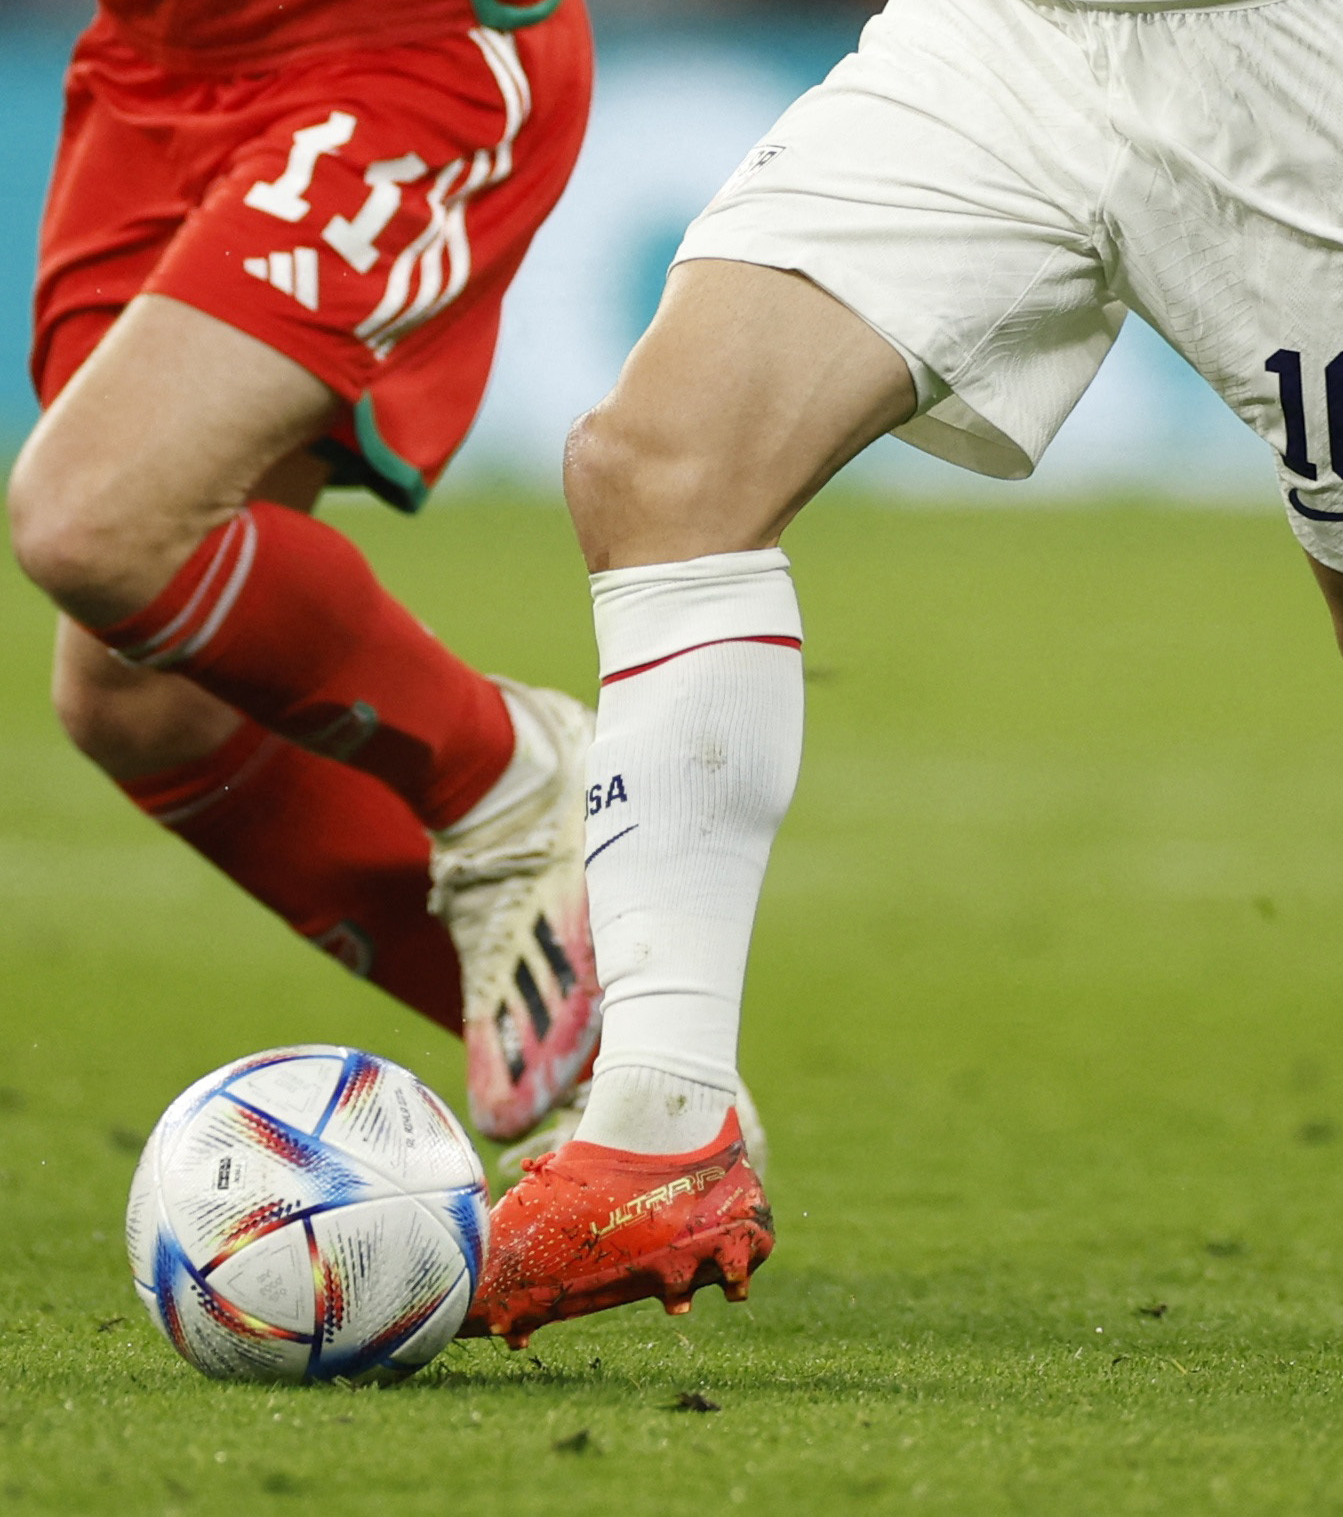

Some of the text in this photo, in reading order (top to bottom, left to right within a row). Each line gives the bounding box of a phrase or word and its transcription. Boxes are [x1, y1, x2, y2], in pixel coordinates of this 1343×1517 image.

[243, 110, 428, 274] 11
[584, 774, 627, 821] SA
[589, 1176, 694, 1236] ULTRA
